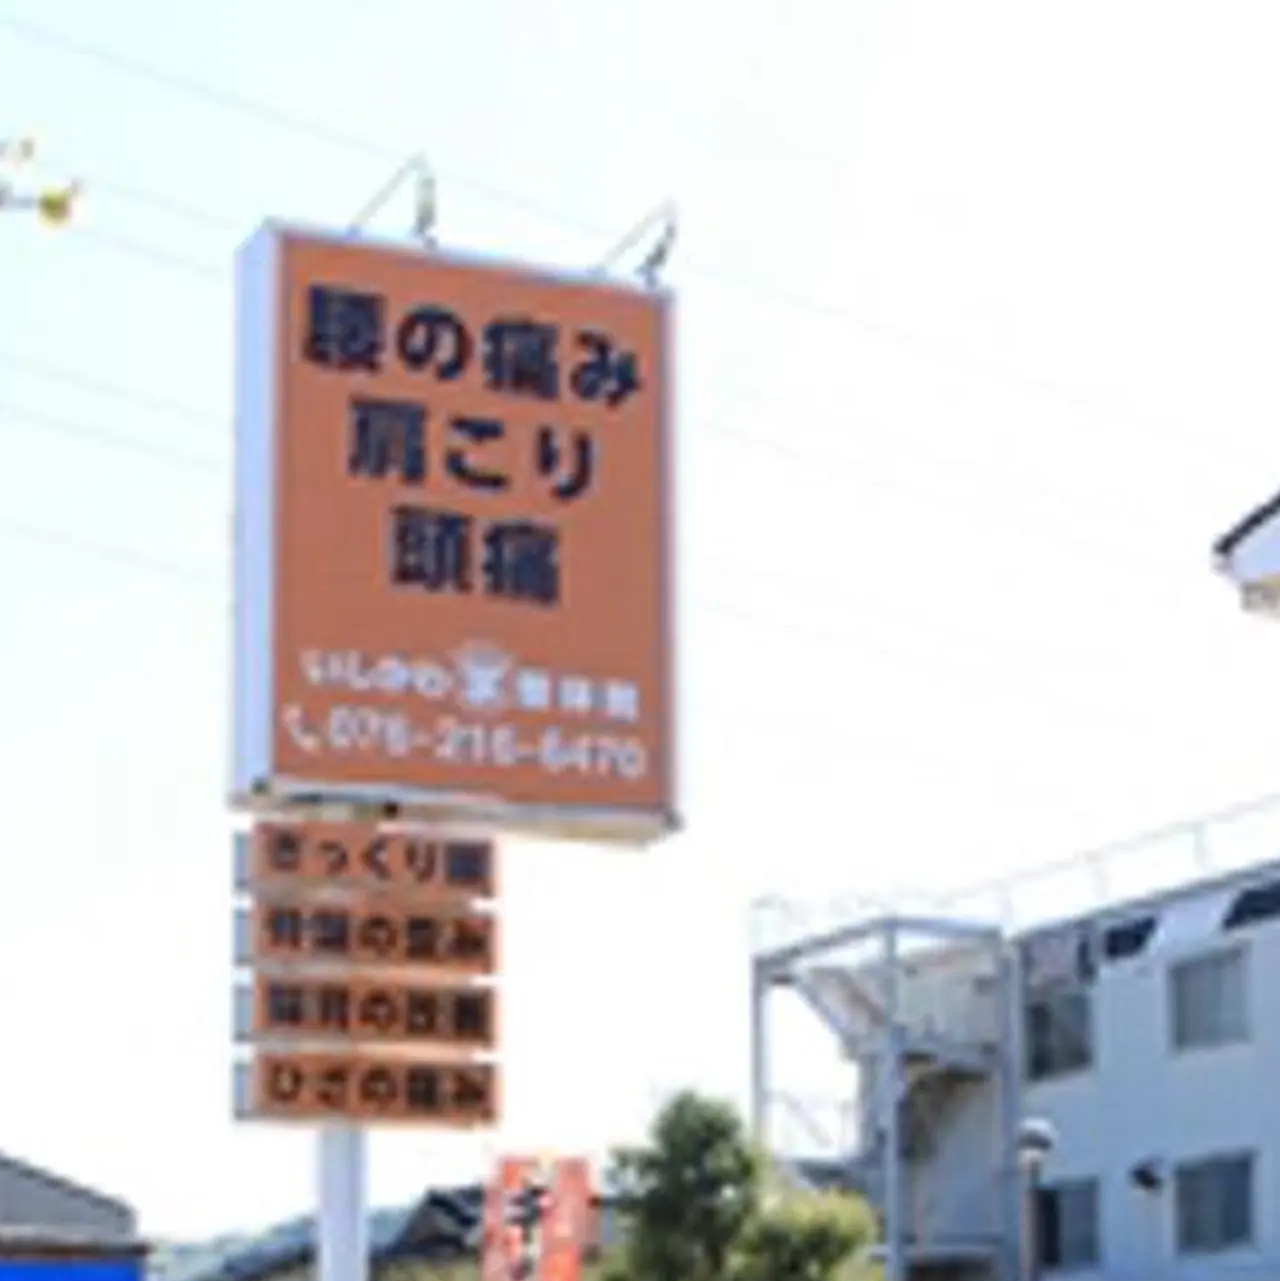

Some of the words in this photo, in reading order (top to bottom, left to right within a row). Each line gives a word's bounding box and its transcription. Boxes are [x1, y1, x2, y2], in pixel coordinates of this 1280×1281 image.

[302, 284, 640, 408] 腰の痛み
[348, 395, 595, 499] 肩こり
[391, 504, 560, 607] 頭痛
